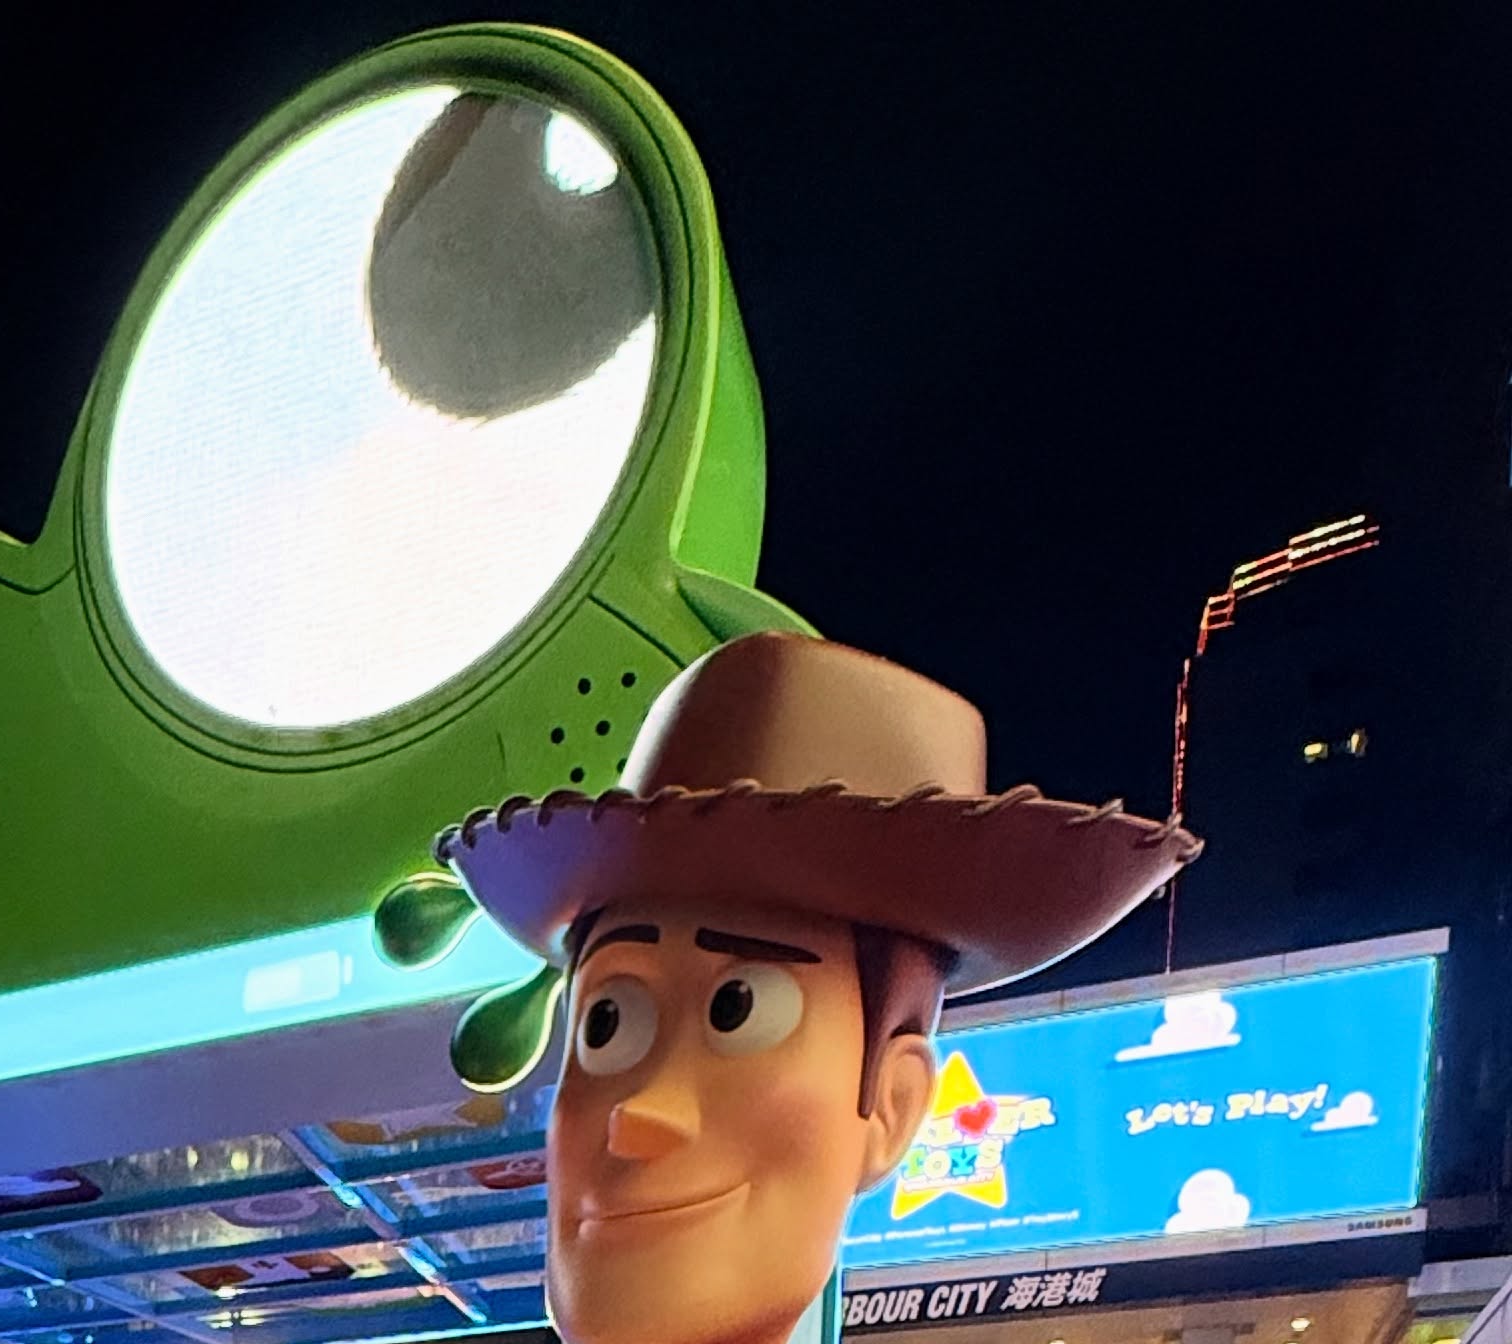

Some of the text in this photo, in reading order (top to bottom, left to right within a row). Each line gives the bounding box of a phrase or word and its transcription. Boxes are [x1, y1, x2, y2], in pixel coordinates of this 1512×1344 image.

[1125, 1083, 1329, 1136] Let's Play!
[842, 1267, 1107, 1328] BOUR CITY 海港城
